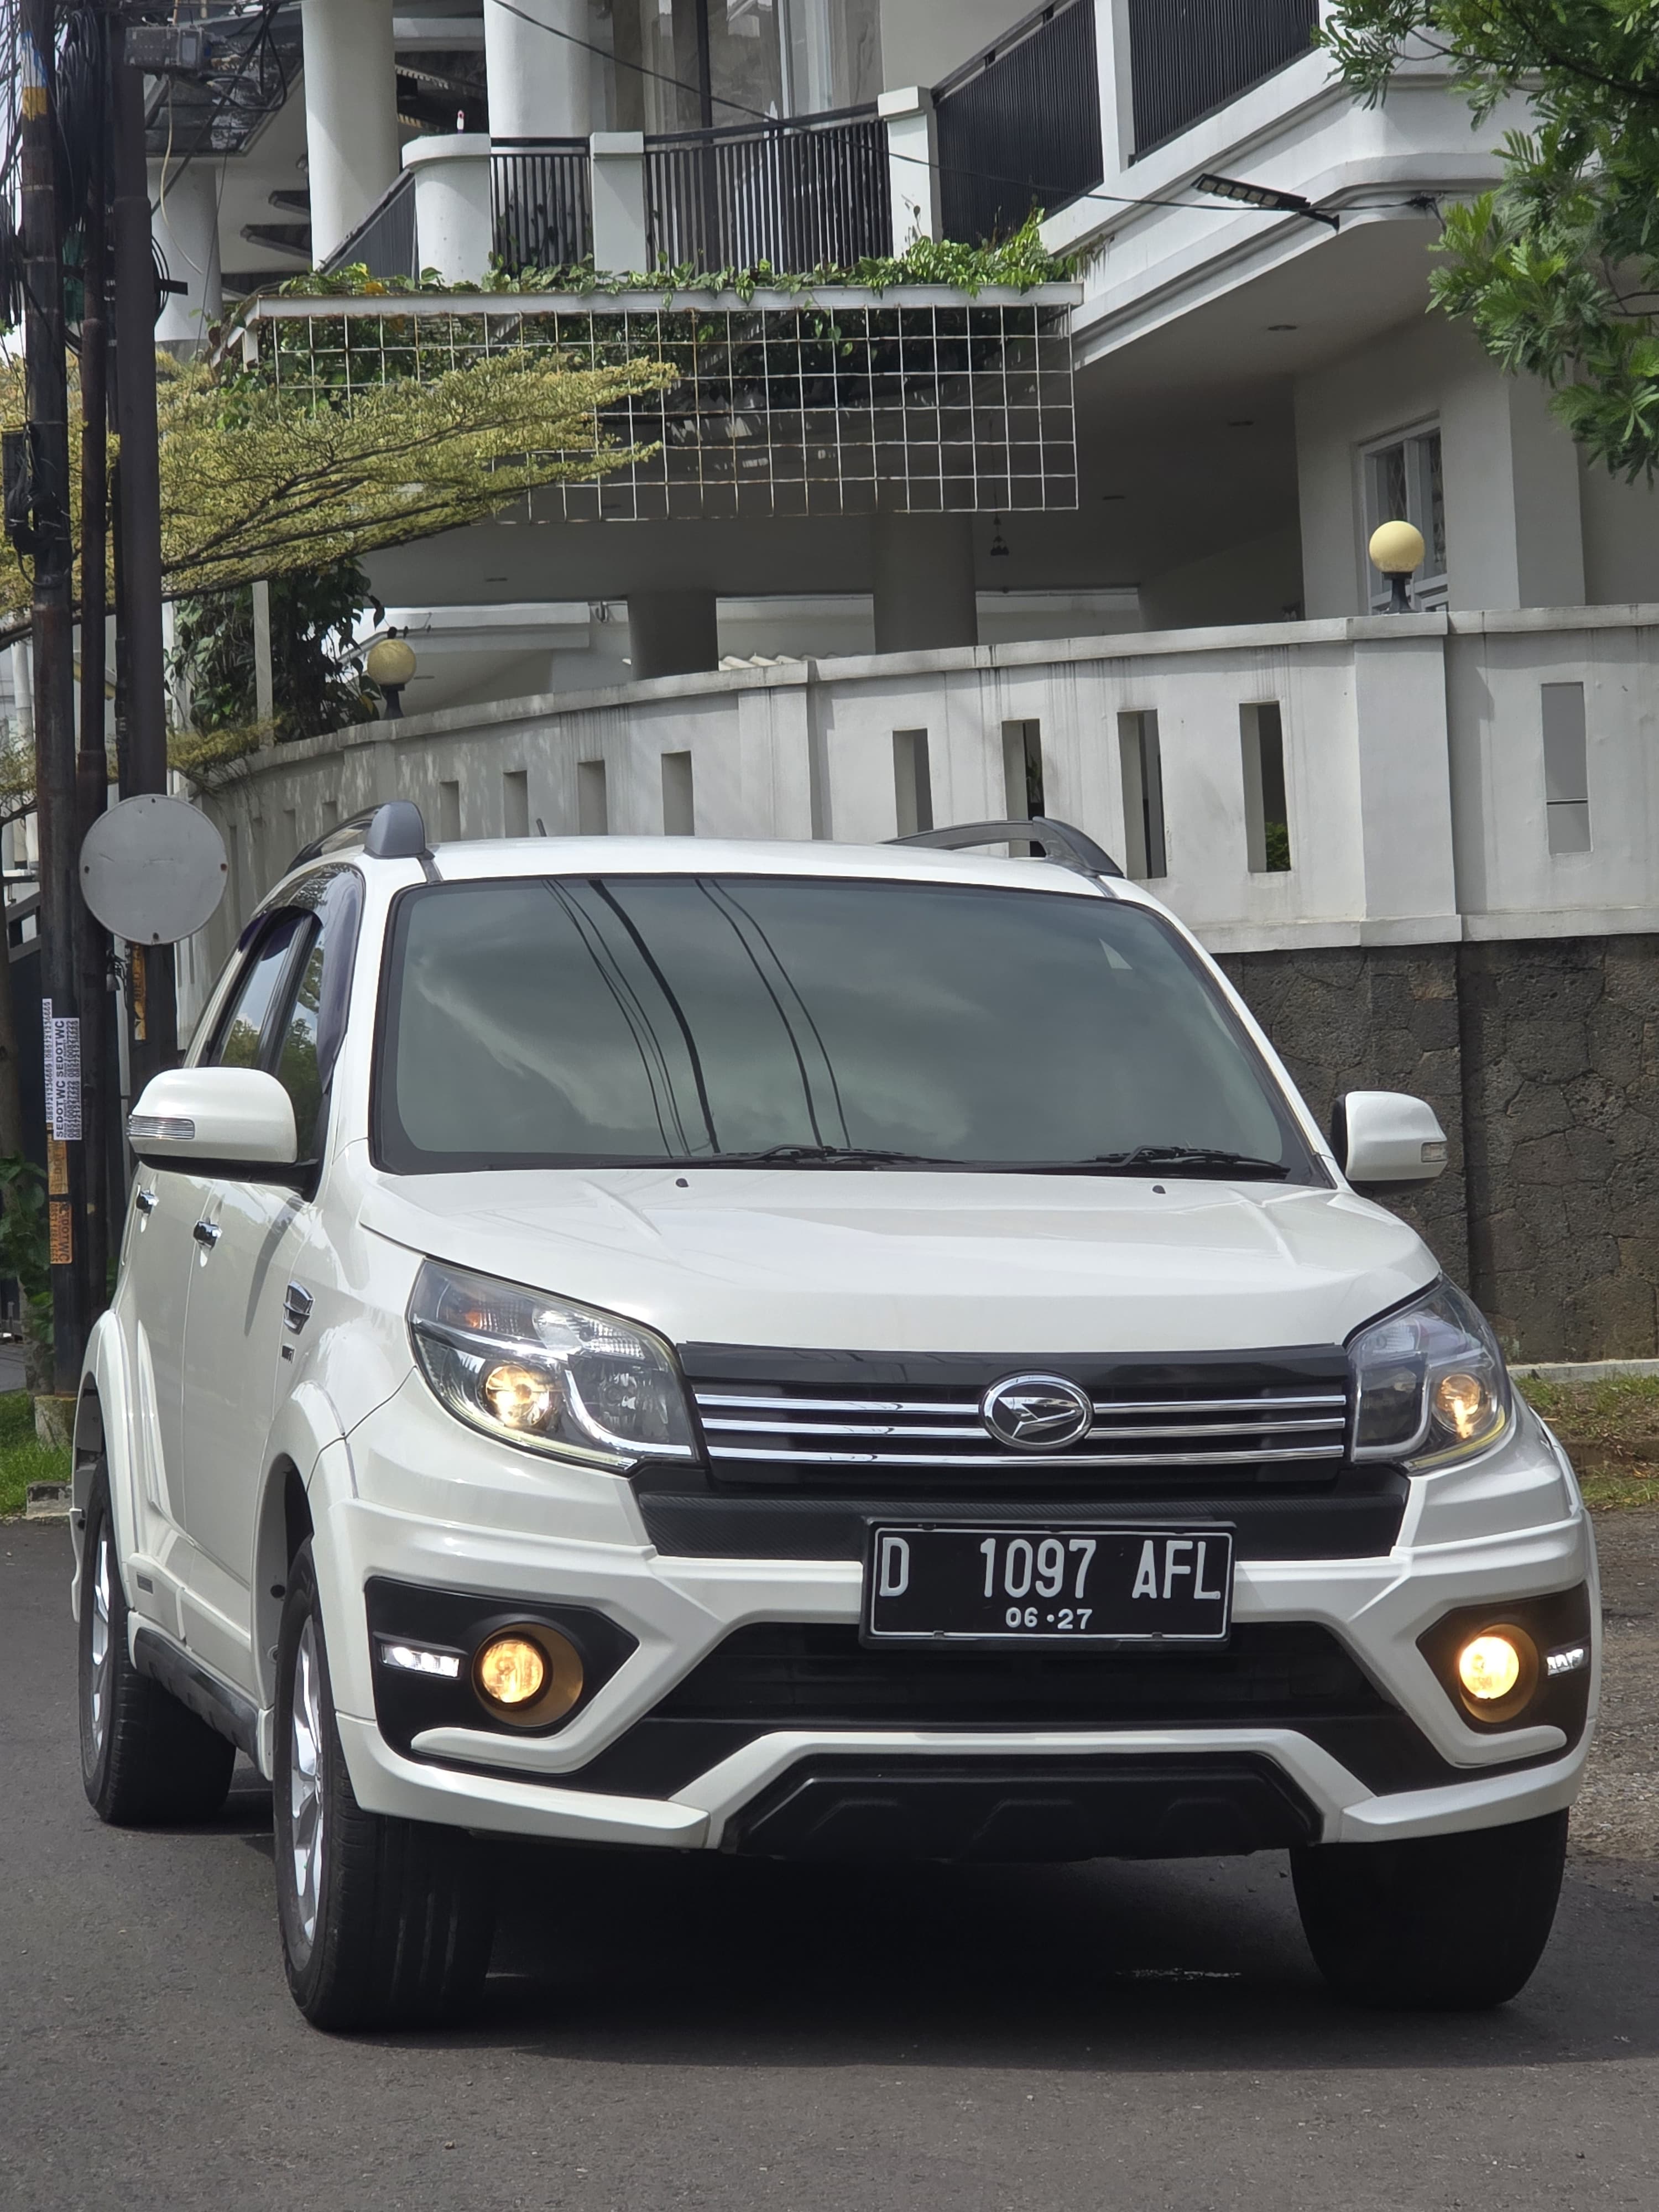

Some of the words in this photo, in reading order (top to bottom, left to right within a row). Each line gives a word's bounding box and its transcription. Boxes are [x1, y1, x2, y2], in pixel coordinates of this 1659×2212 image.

[880, 1537, 909, 1597] D
[980, 1538, 1097, 1599] 1097
[1131, 1540, 1221, 1599] AFL
